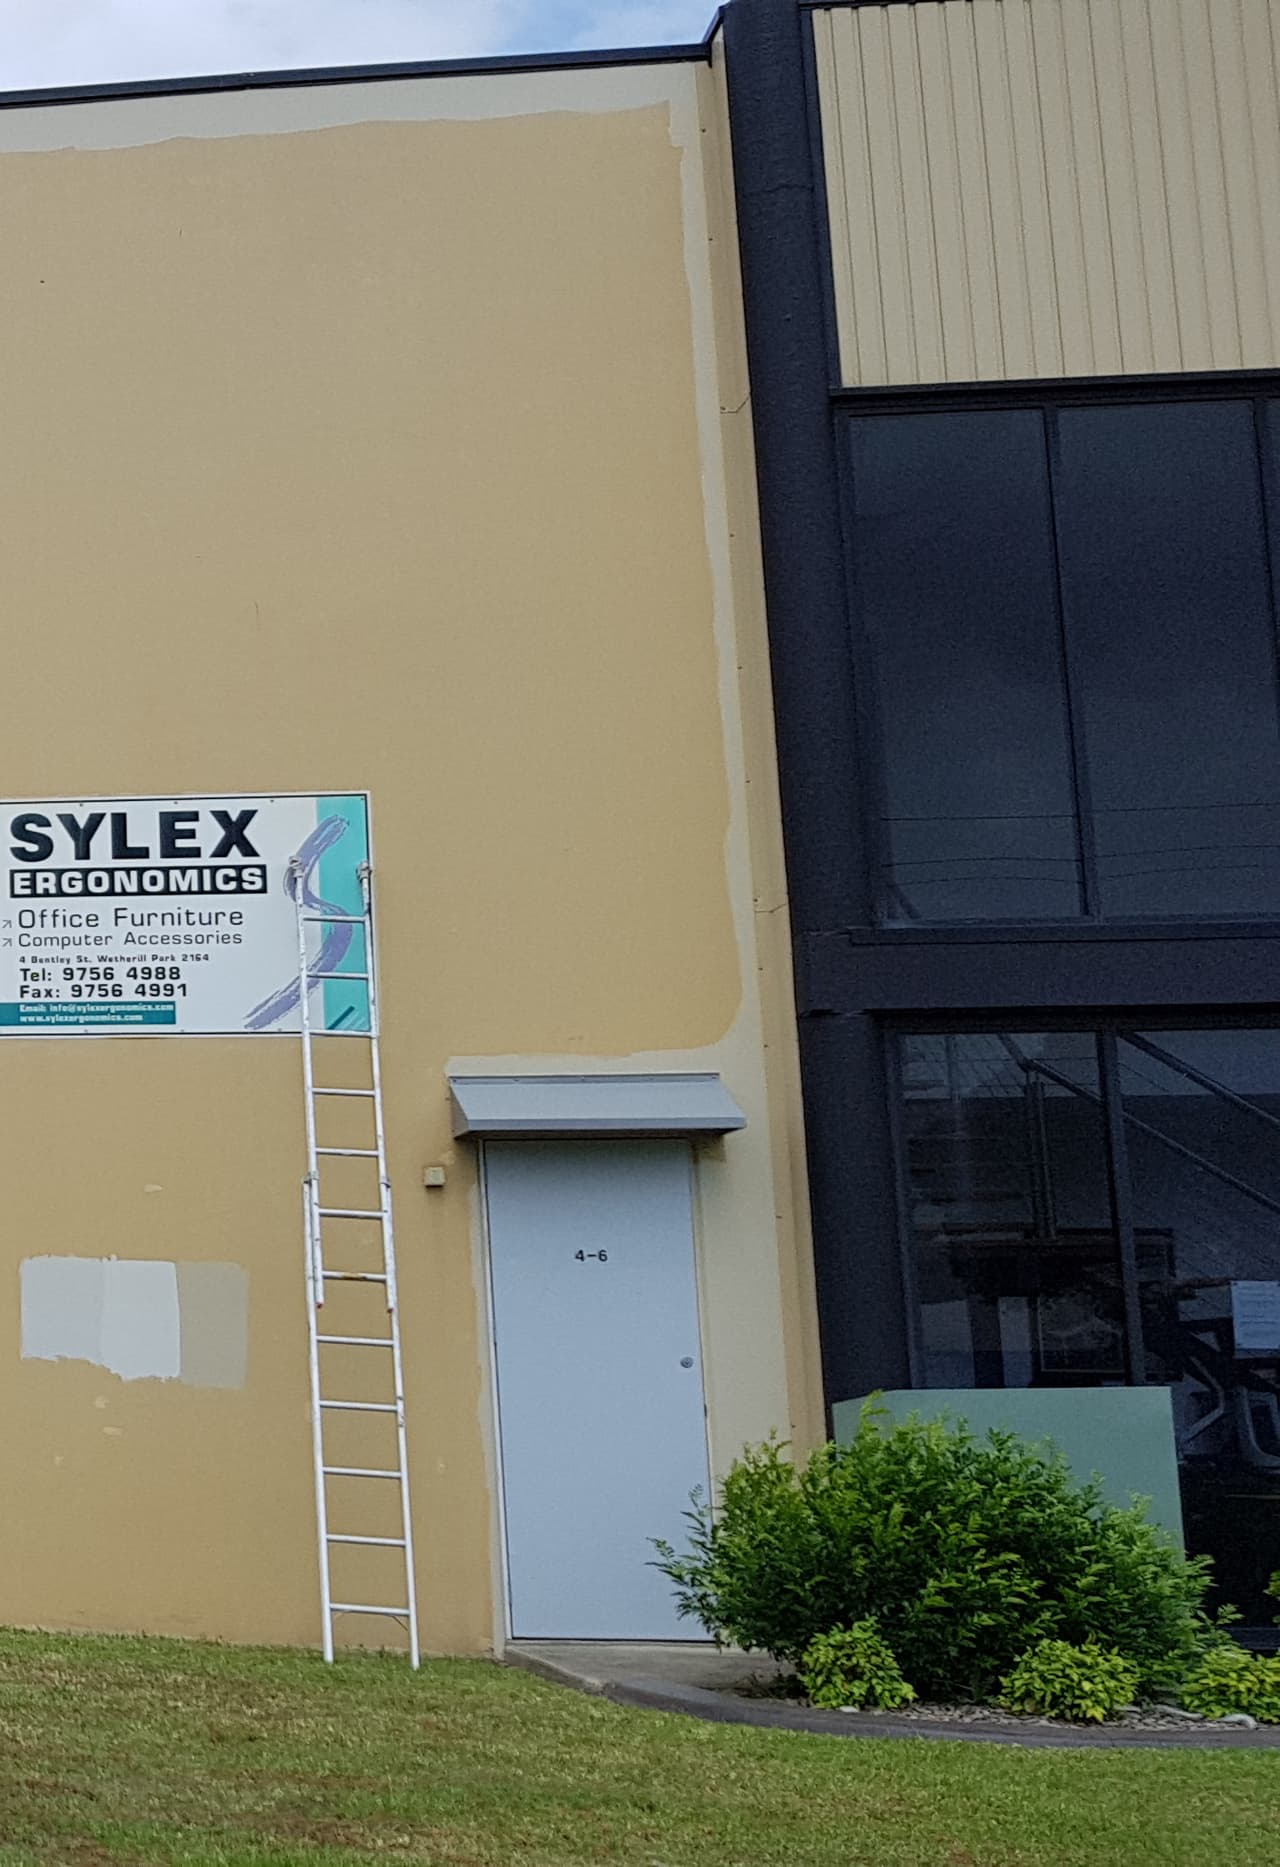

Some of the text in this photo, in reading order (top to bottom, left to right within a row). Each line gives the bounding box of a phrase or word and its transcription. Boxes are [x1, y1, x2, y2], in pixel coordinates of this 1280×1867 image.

[10, 809, 261, 863] SYLEX
[13, 867, 264, 896] ERGONOMICS
[18, 907, 244, 929] Office Furniture
[18, 930, 243, 950] Computer Accessories
[19, 955, 26, 964] 4
[31, 955, 71, 965] Bentley
[97, 953, 147, 963] Wetherill
[151, 953, 176, 962] Park
[181, 953, 210, 962] 2164
[20, 966, 181, 982] Tel: 9756 4988
[20, 983, 187, 998] Fax: 9756 4991
[49, 1003, 174, 1014] info@sylexergonomics.com
[19, 1013, 143, 1024] www.sylexergonomics.com
[575, 1249, 608, 1262] 4-6
